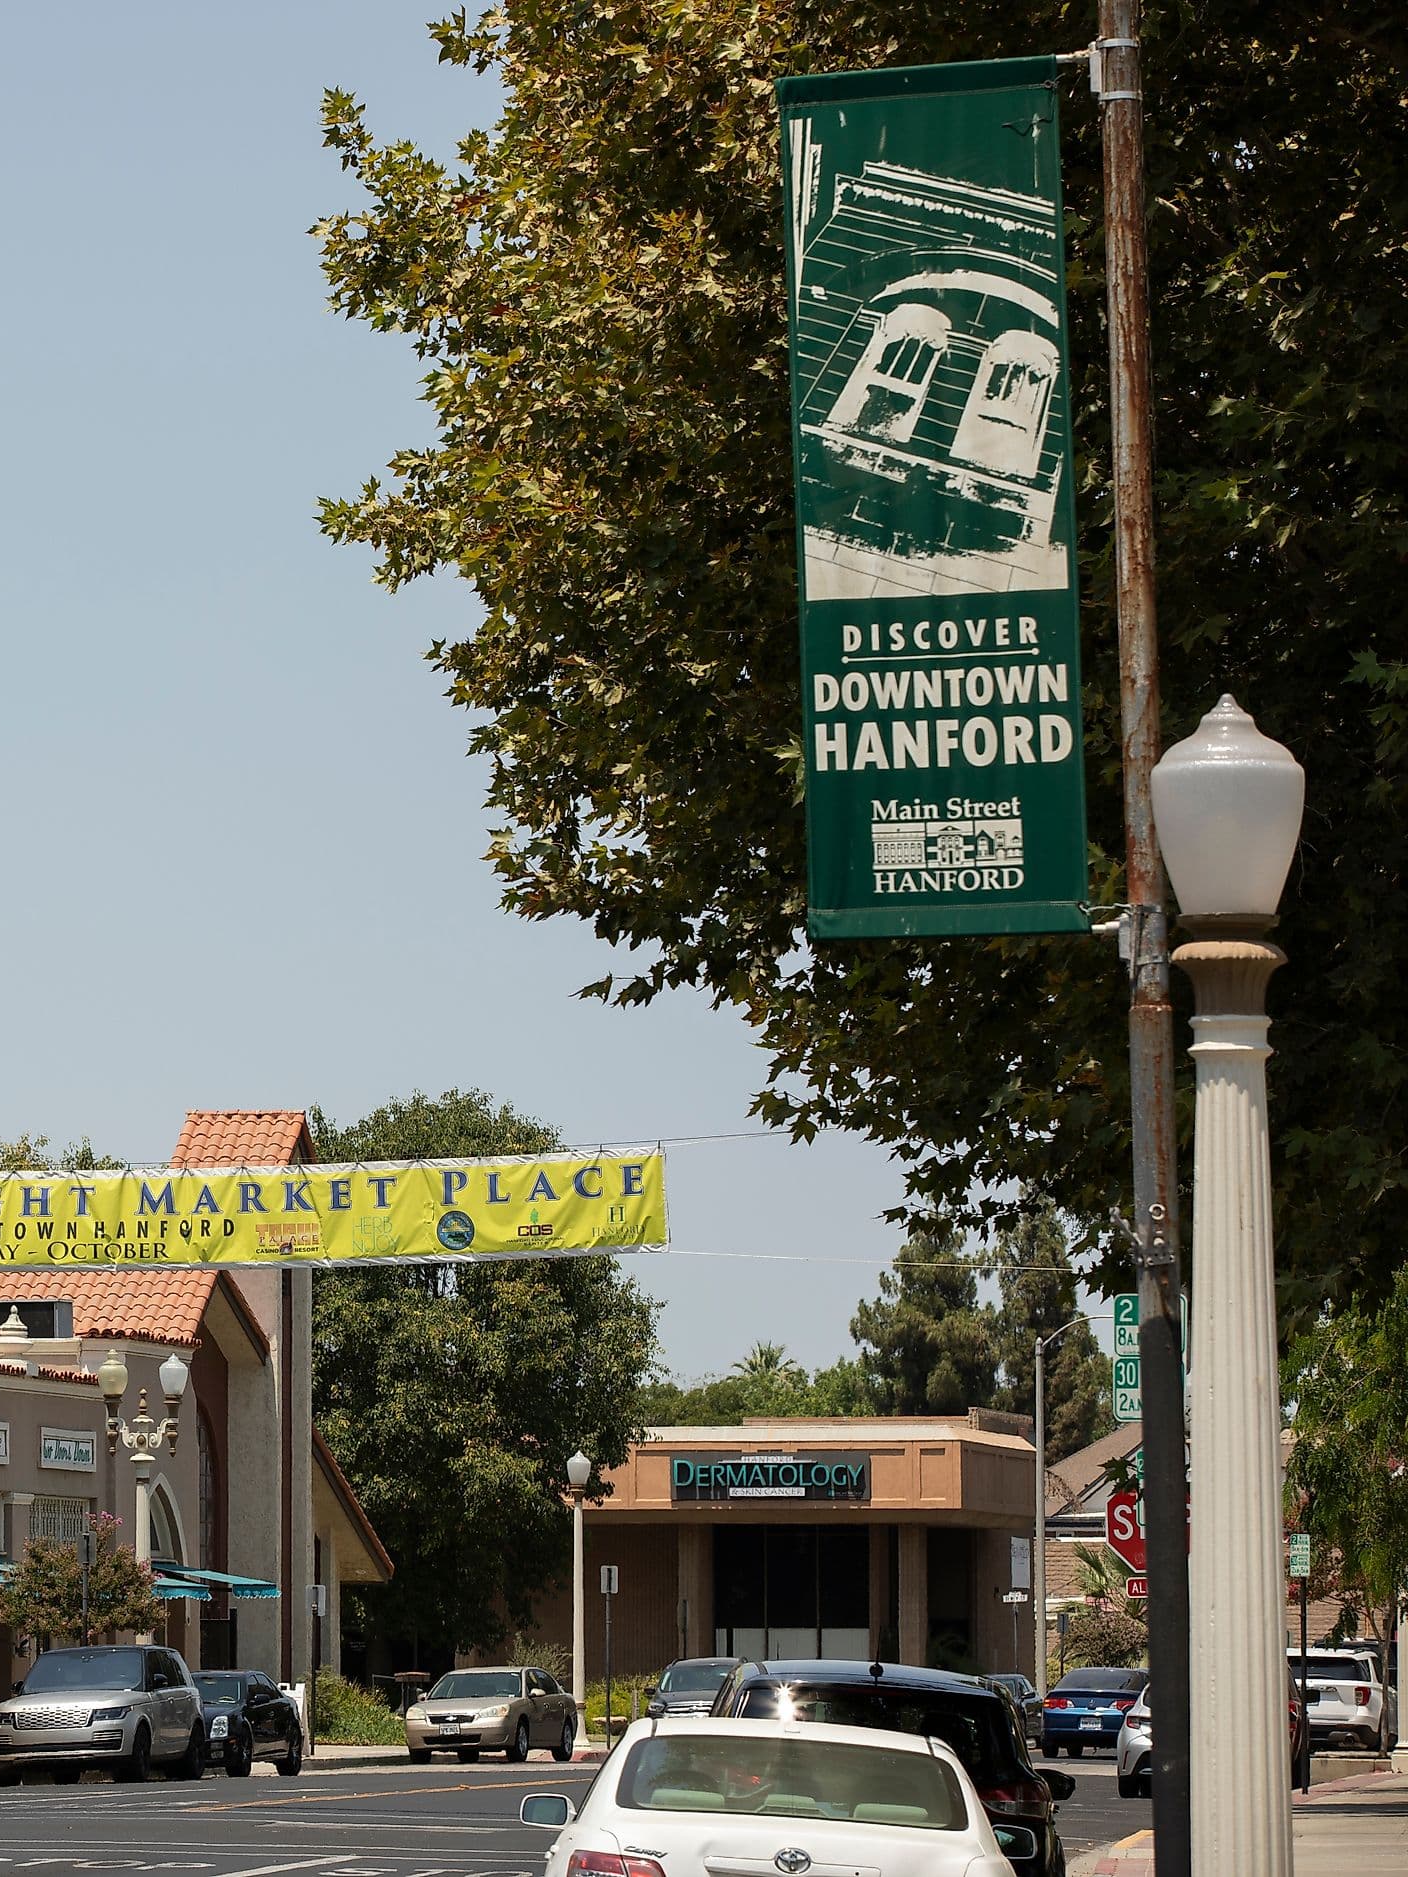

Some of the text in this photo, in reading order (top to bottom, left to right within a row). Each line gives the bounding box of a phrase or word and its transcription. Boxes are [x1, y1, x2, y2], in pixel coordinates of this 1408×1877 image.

[842, 616, 1039, 653] DISCOVER
[813, 663, 1069, 713] DOWNTOWN
[814, 714, 1074, 772] HANFORD
[870, 796, 1022, 821] Main Street
[872, 867, 1025, 894] HANFORD
[135, 1176, 397, 1216] MARKET
[439, 1163, 645, 1207] PLACE
[94, 1219, 235, 1239] HANFORD
[517, 1224, 554, 1237] COS
[47, 1241, 170, 1260] OCTOBER
[1116, 1362, 1137, 1386] 30
[672, 1458, 864, 1487] DERMATOLOGY
[740, 1487, 762, 1496] SKIN
[764, 1487, 803, 1496] CANCER
